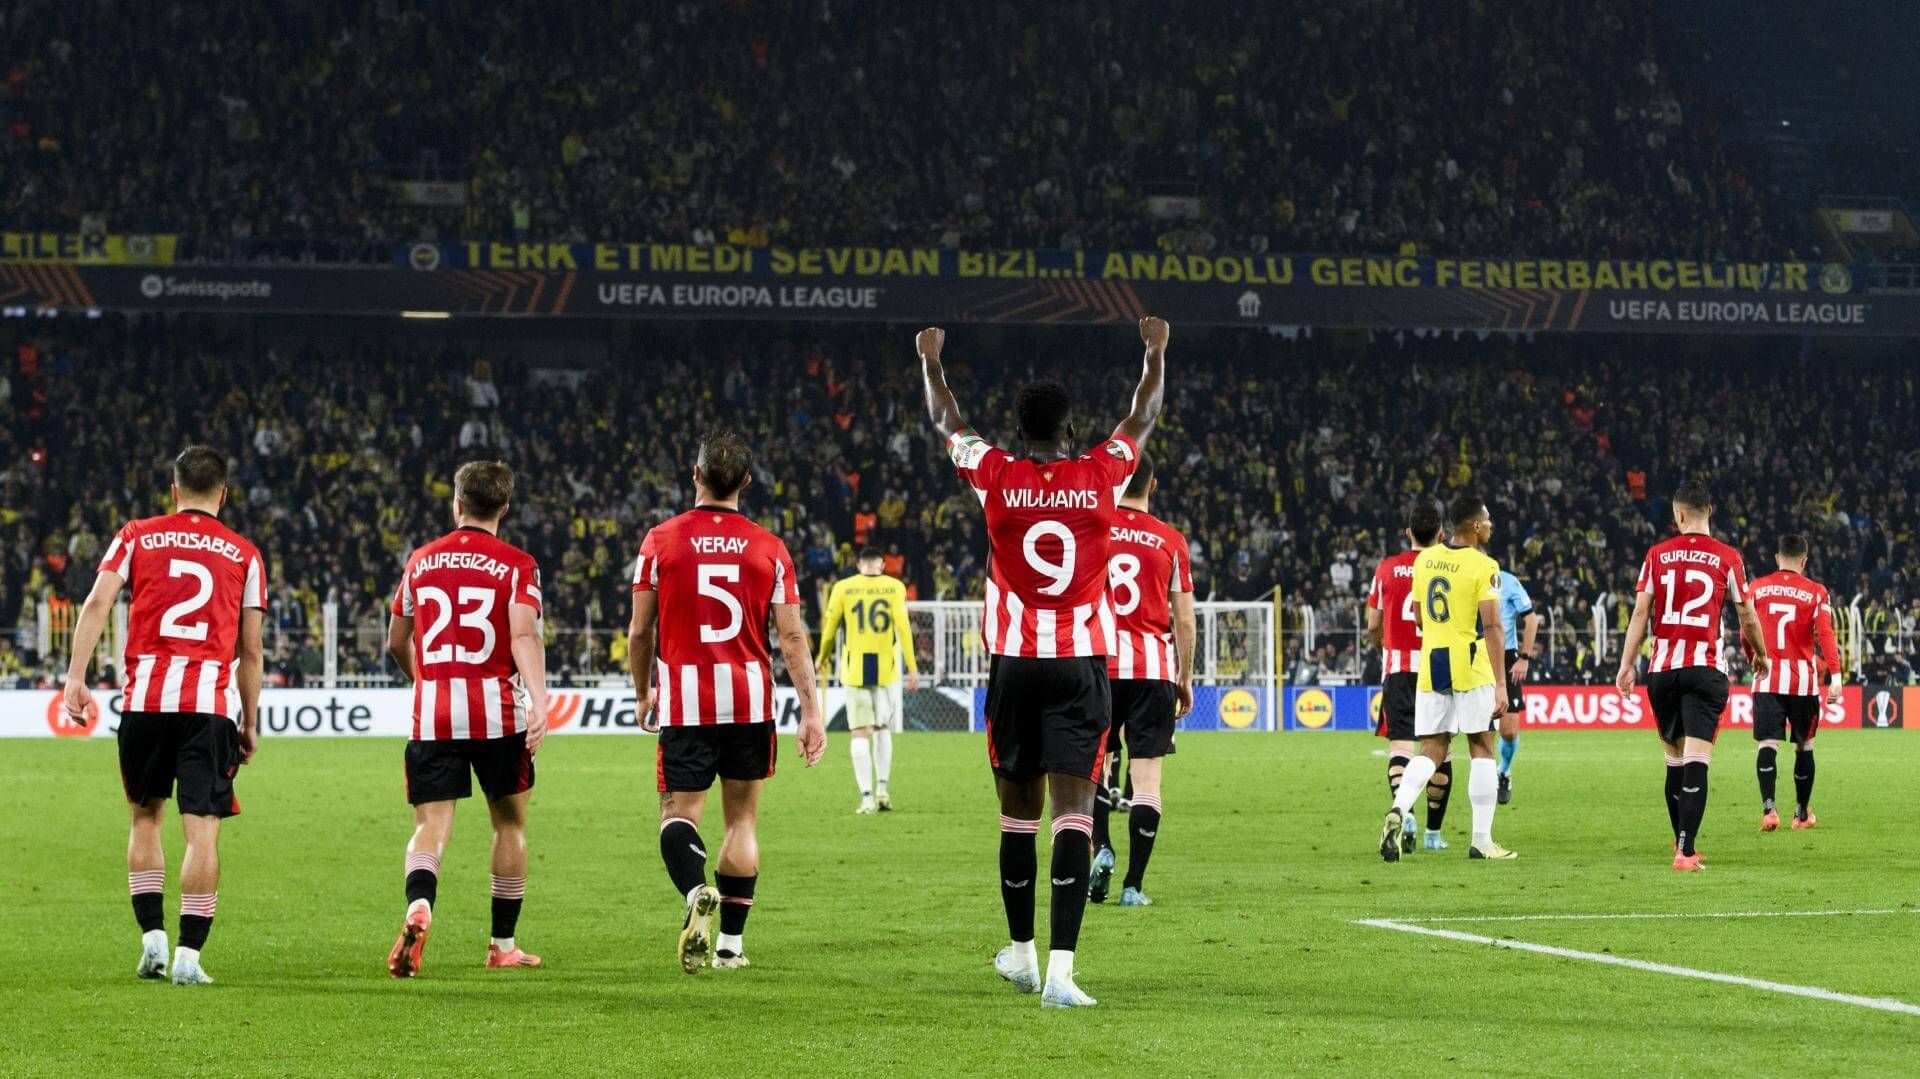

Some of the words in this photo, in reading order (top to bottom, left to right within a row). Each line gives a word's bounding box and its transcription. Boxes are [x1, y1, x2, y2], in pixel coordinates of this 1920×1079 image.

[770, 247, 940, 275] SEVDAN
[1102, 252, 1294, 285] ANADOLU
[165, 277, 272, 299] Swissquote
[597, 283, 667, 305] UEFA
[673, 284, 773, 307] EUROPA
[780, 286, 878, 308] LEAGUE
[1609, 300, 1672, 321] UEFA
[1677, 302, 1770, 323] EUROPA
[1776, 303, 1865, 324] LEAGUE
[1002, 488, 1098, 510] WILLIAMS
[139, 531, 245, 563] GOROSABEL
[690, 536, 749, 554] YERAY
[1110, 526, 1165, 550] SANCET
[411, 552, 510, 580] JAUREGIZAR
[1022, 520, 1077, 596] 9
[1425, 559, 1460, 573] DJIKU
[1659, 550, 1721, 569] GURUZETA
[159, 558, 214, 641] 2
[1110, 553, 1140, 616] 8
[1426, 575, 1451, 623] 6
[1660, 569, 1714, 628] 12
[1755, 585, 1814, 604] BERENGUER
[697, 564, 743, 643] 5
[851, 599, 892, 633] 16
[416, 586, 496, 666] 23
[1768, 602, 1797, 650] 7
